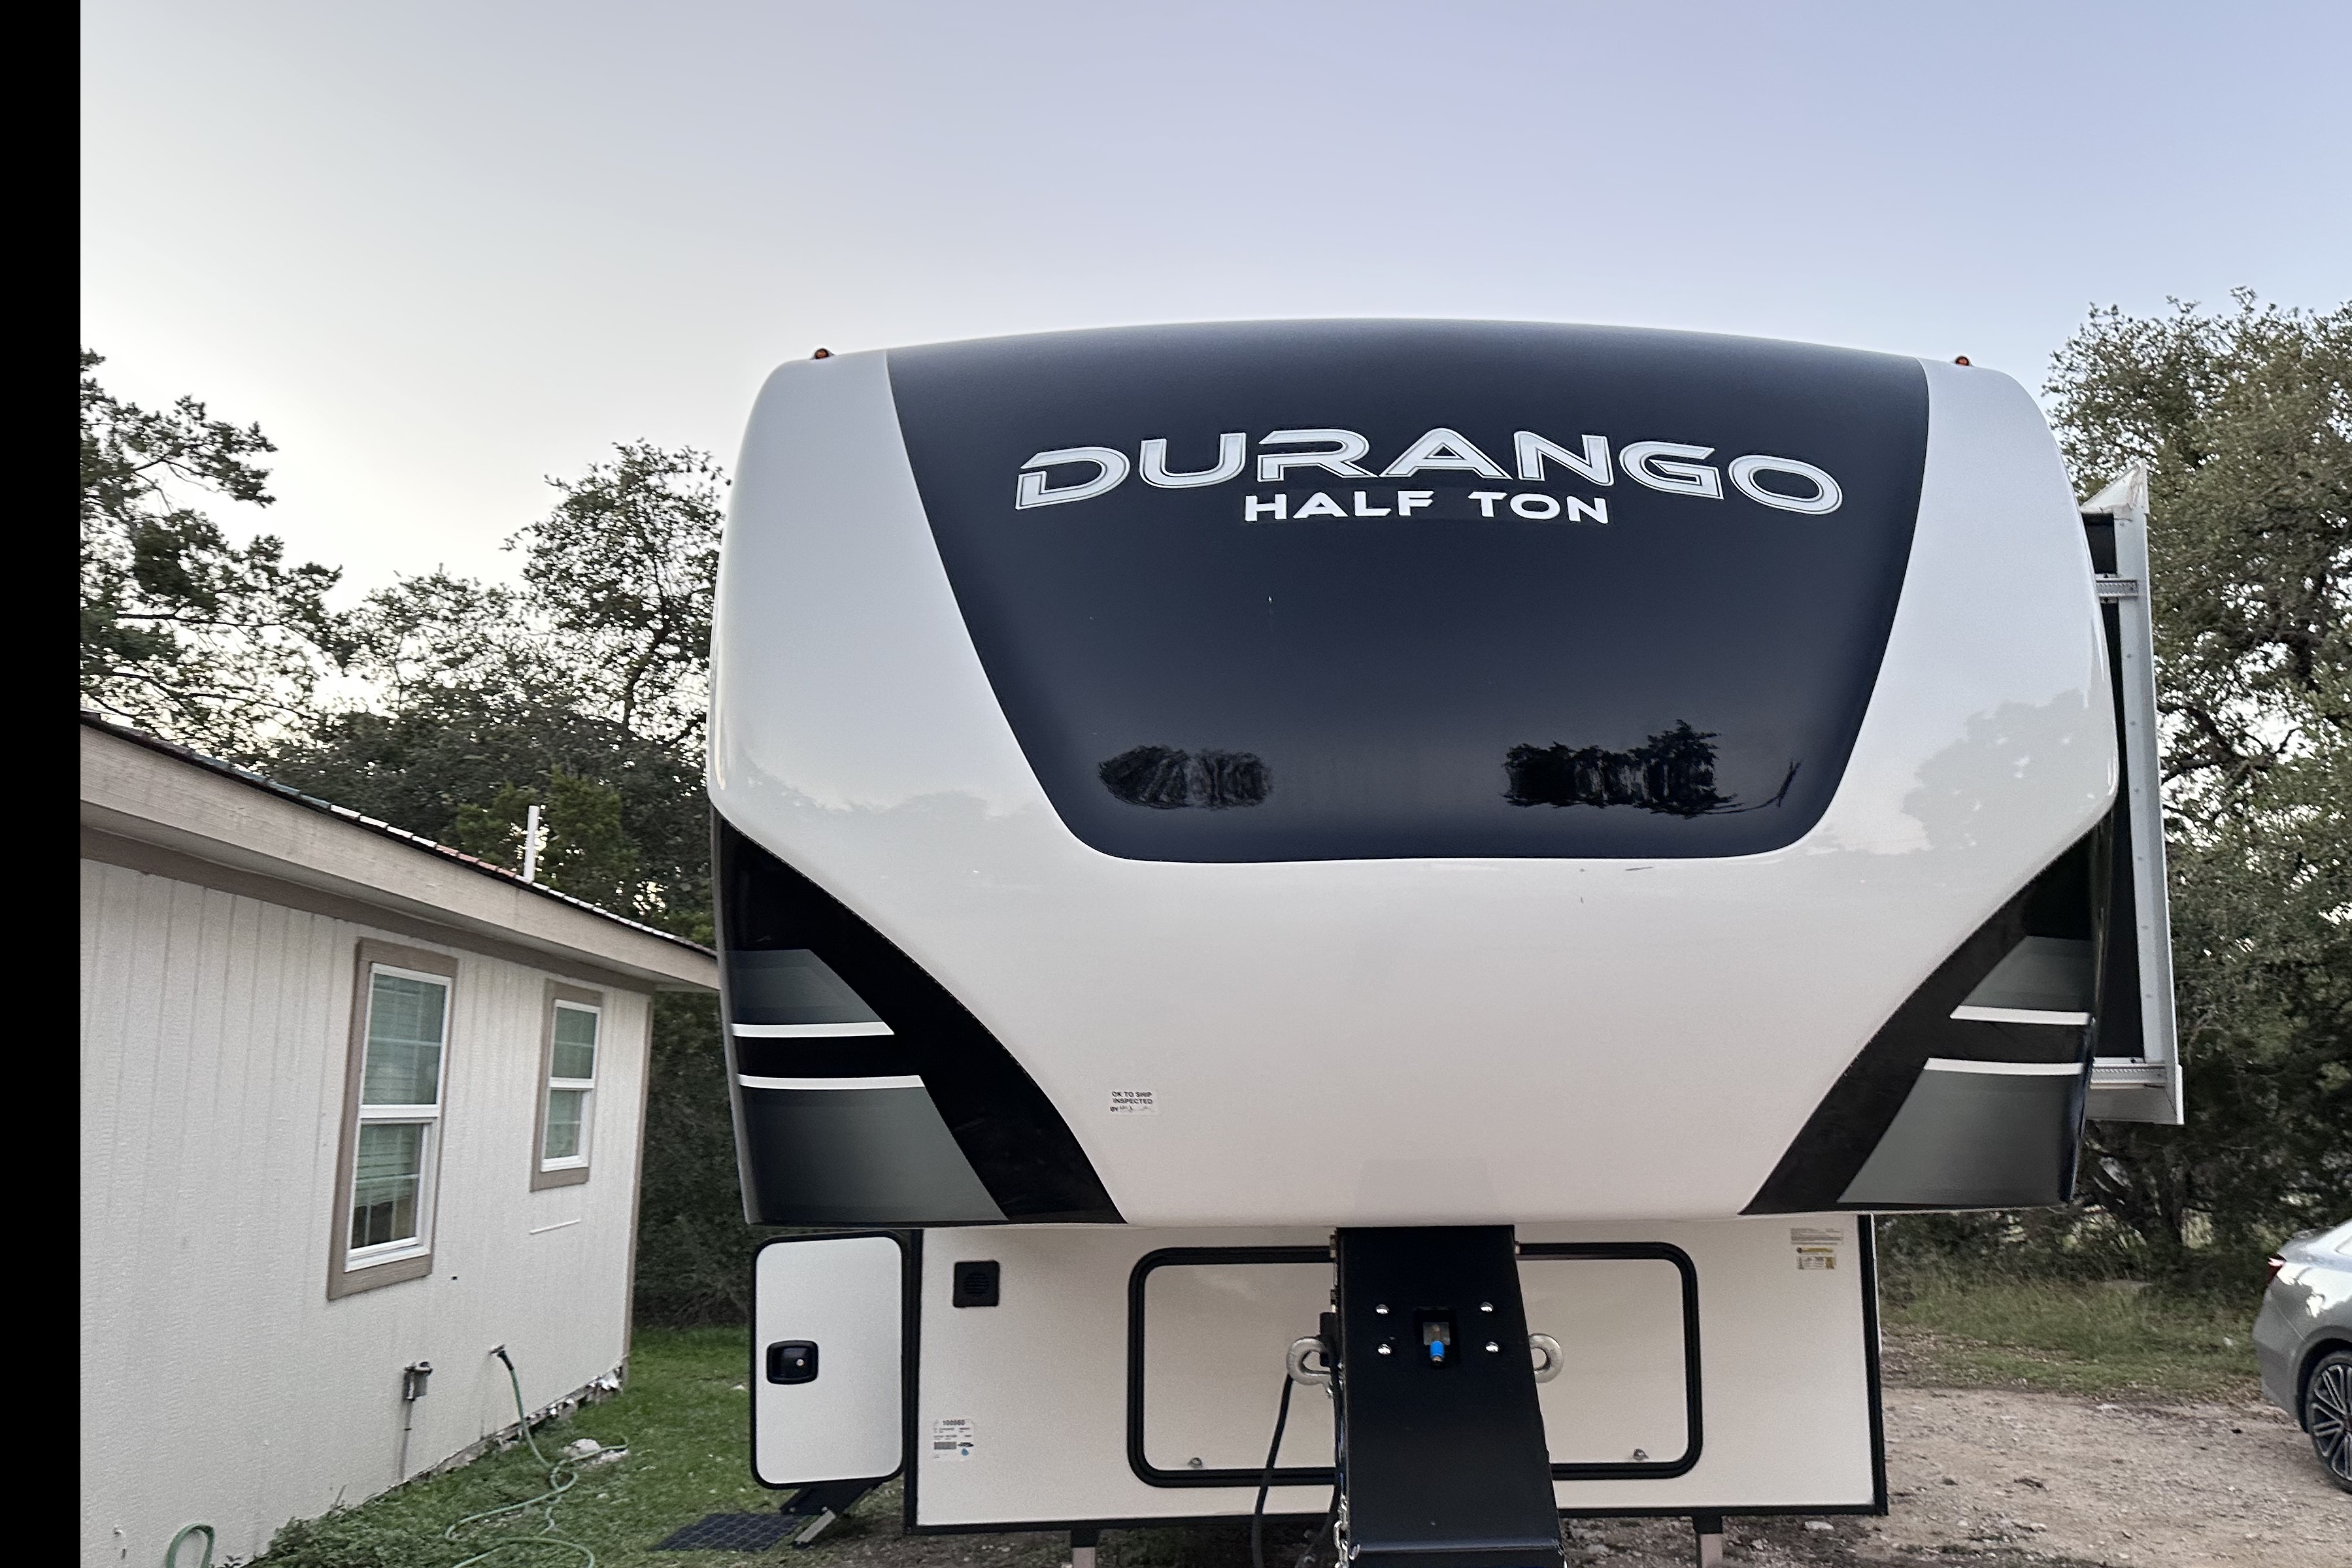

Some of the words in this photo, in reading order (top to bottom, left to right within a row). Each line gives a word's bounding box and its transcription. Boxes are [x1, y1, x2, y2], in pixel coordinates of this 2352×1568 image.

[1015, 427, 1843, 515] DURANGO
[1245, 491, 1434, 522] HALF
[1468, 491, 1609, 524] TON
